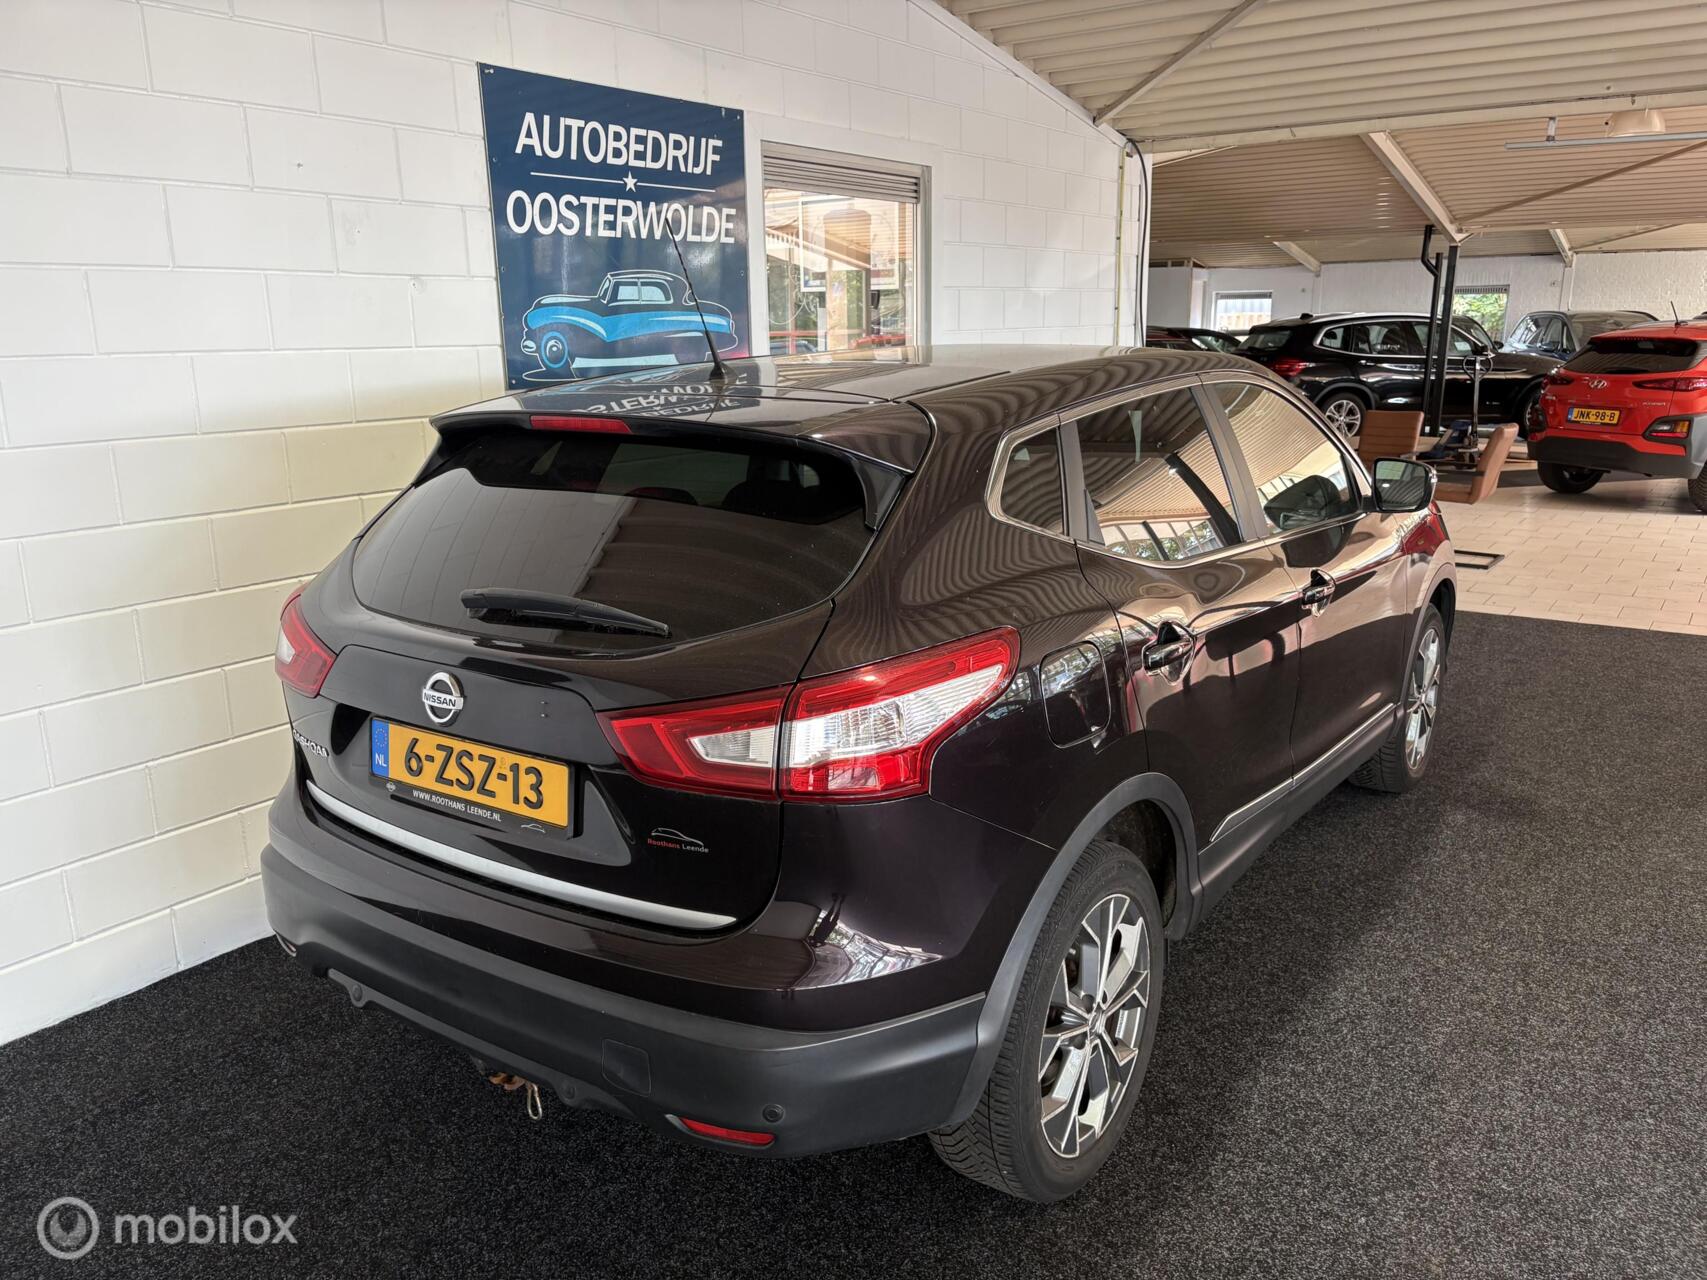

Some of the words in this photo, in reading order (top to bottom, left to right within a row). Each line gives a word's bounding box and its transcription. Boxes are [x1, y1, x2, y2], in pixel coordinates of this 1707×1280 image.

[514, 112, 723, 176] AUTOBEDRIJF
[506, 190, 736, 244] OOSTERWOLDE
[1574, 407, 1615, 421] JNK-98-B
[423, 691, 457, 708] NISSAN
[375, 753, 387, 767] NL
[404, 737, 544, 810] 6-ZSZ-13
[466, 804, 502, 822] LEENDE.NL
[647, 838, 681, 849] Roothans
[681, 843, 709, 853] Leende
